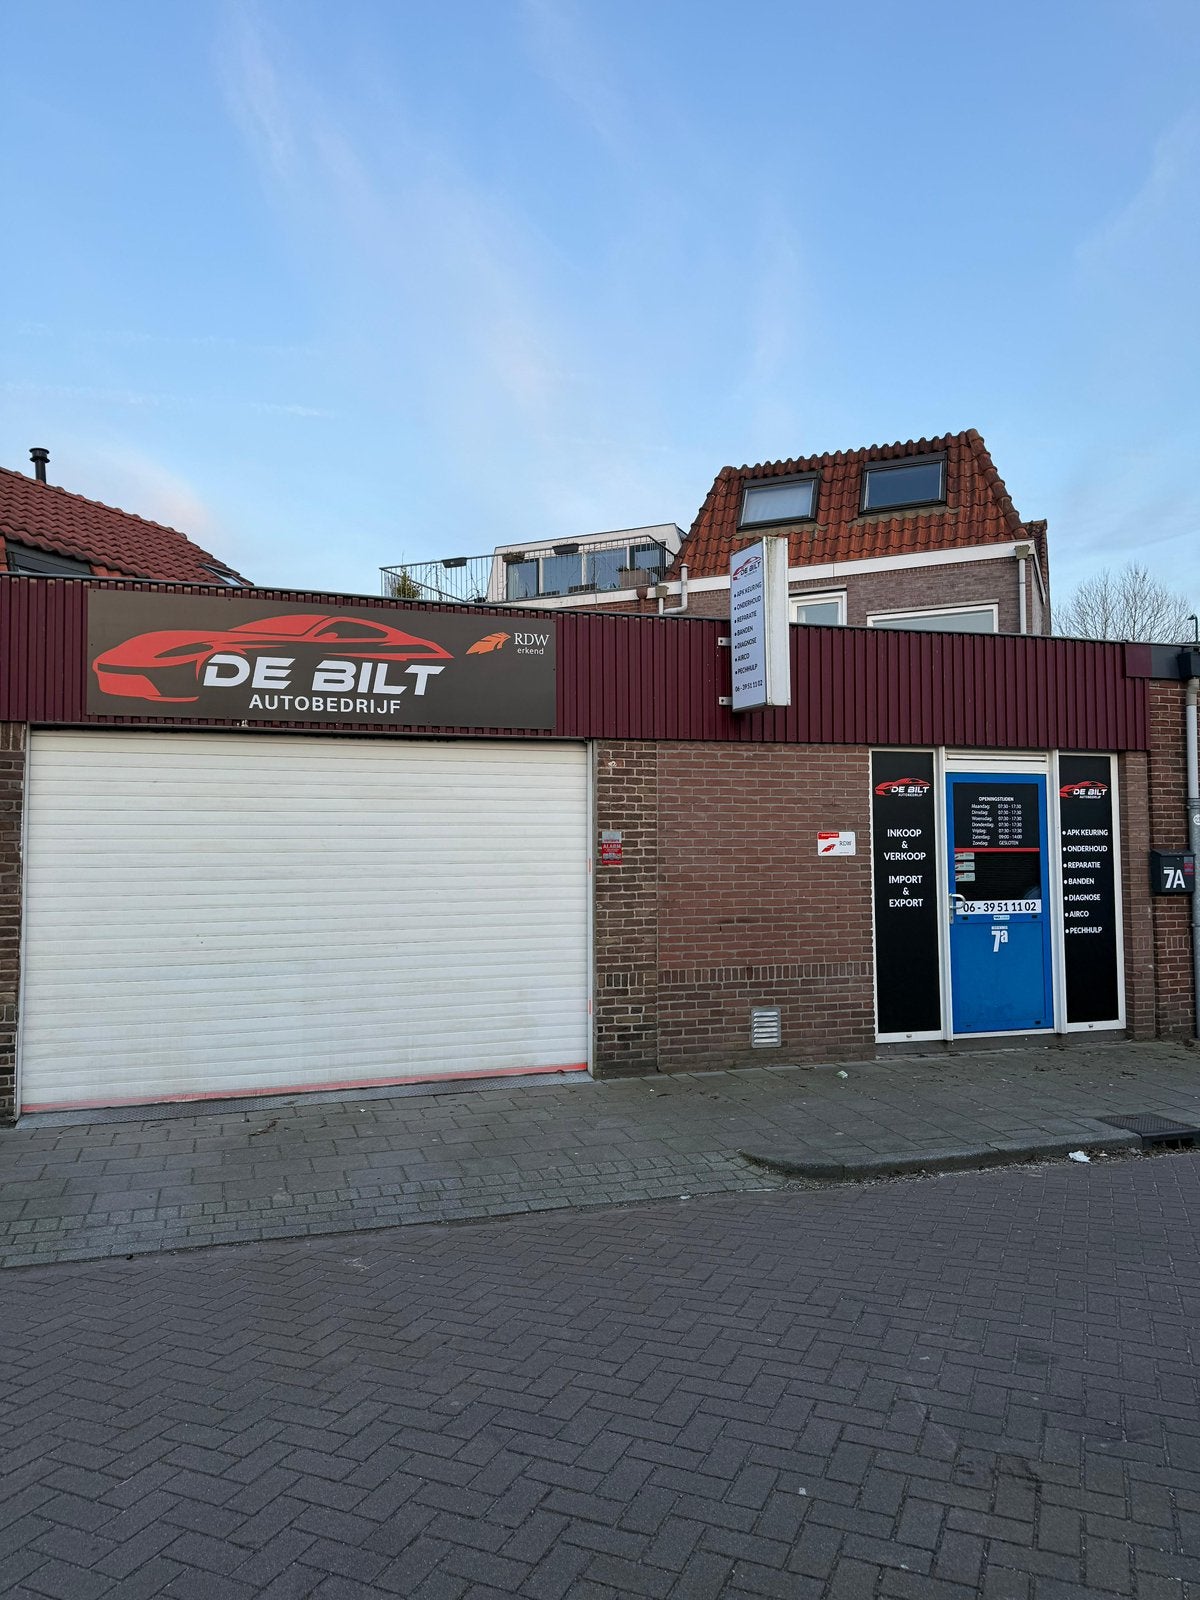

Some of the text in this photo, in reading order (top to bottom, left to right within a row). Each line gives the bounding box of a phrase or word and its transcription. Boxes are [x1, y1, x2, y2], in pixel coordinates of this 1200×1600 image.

[740, 567, 748, 576] DE
[749, 560, 761, 572] BILT
[745, 581, 762, 593] KEURING
[736, 595, 762, 610] ONDERHOUD
[736, 610, 757, 624] REPARATIE
[737, 625, 754, 637] BANDEN
[513, 632, 550, 646] RDW
[737, 637, 757, 650] DIAGNOSE
[517, 646, 544, 655] erkend
[738, 652, 750, 662] AIRCO
[203, 654, 446, 696] DE BILT
[738, 664, 758, 676] PECHHULP
[248, 694, 401, 714] AUTOBEDRIJF
[887, 828, 922, 838] INKOOP
[902, 840, 908, 848] &
[884, 852, 926, 860] VERKOOP
[888, 876, 922, 884] IMPORT
[1163, 869, 1186, 888] 7A
[902, 887, 910, 895] &
[888, 898, 924, 907] EXPORT
[963, 902, 976, 912] 06
[984, 902, 996, 912] 39
[997, 902, 1010, 912] 51
[1012, 902, 1024, 912] 11
[1024, 902, 1036, 911] 02
[991, 930, 1008, 952] 7a
